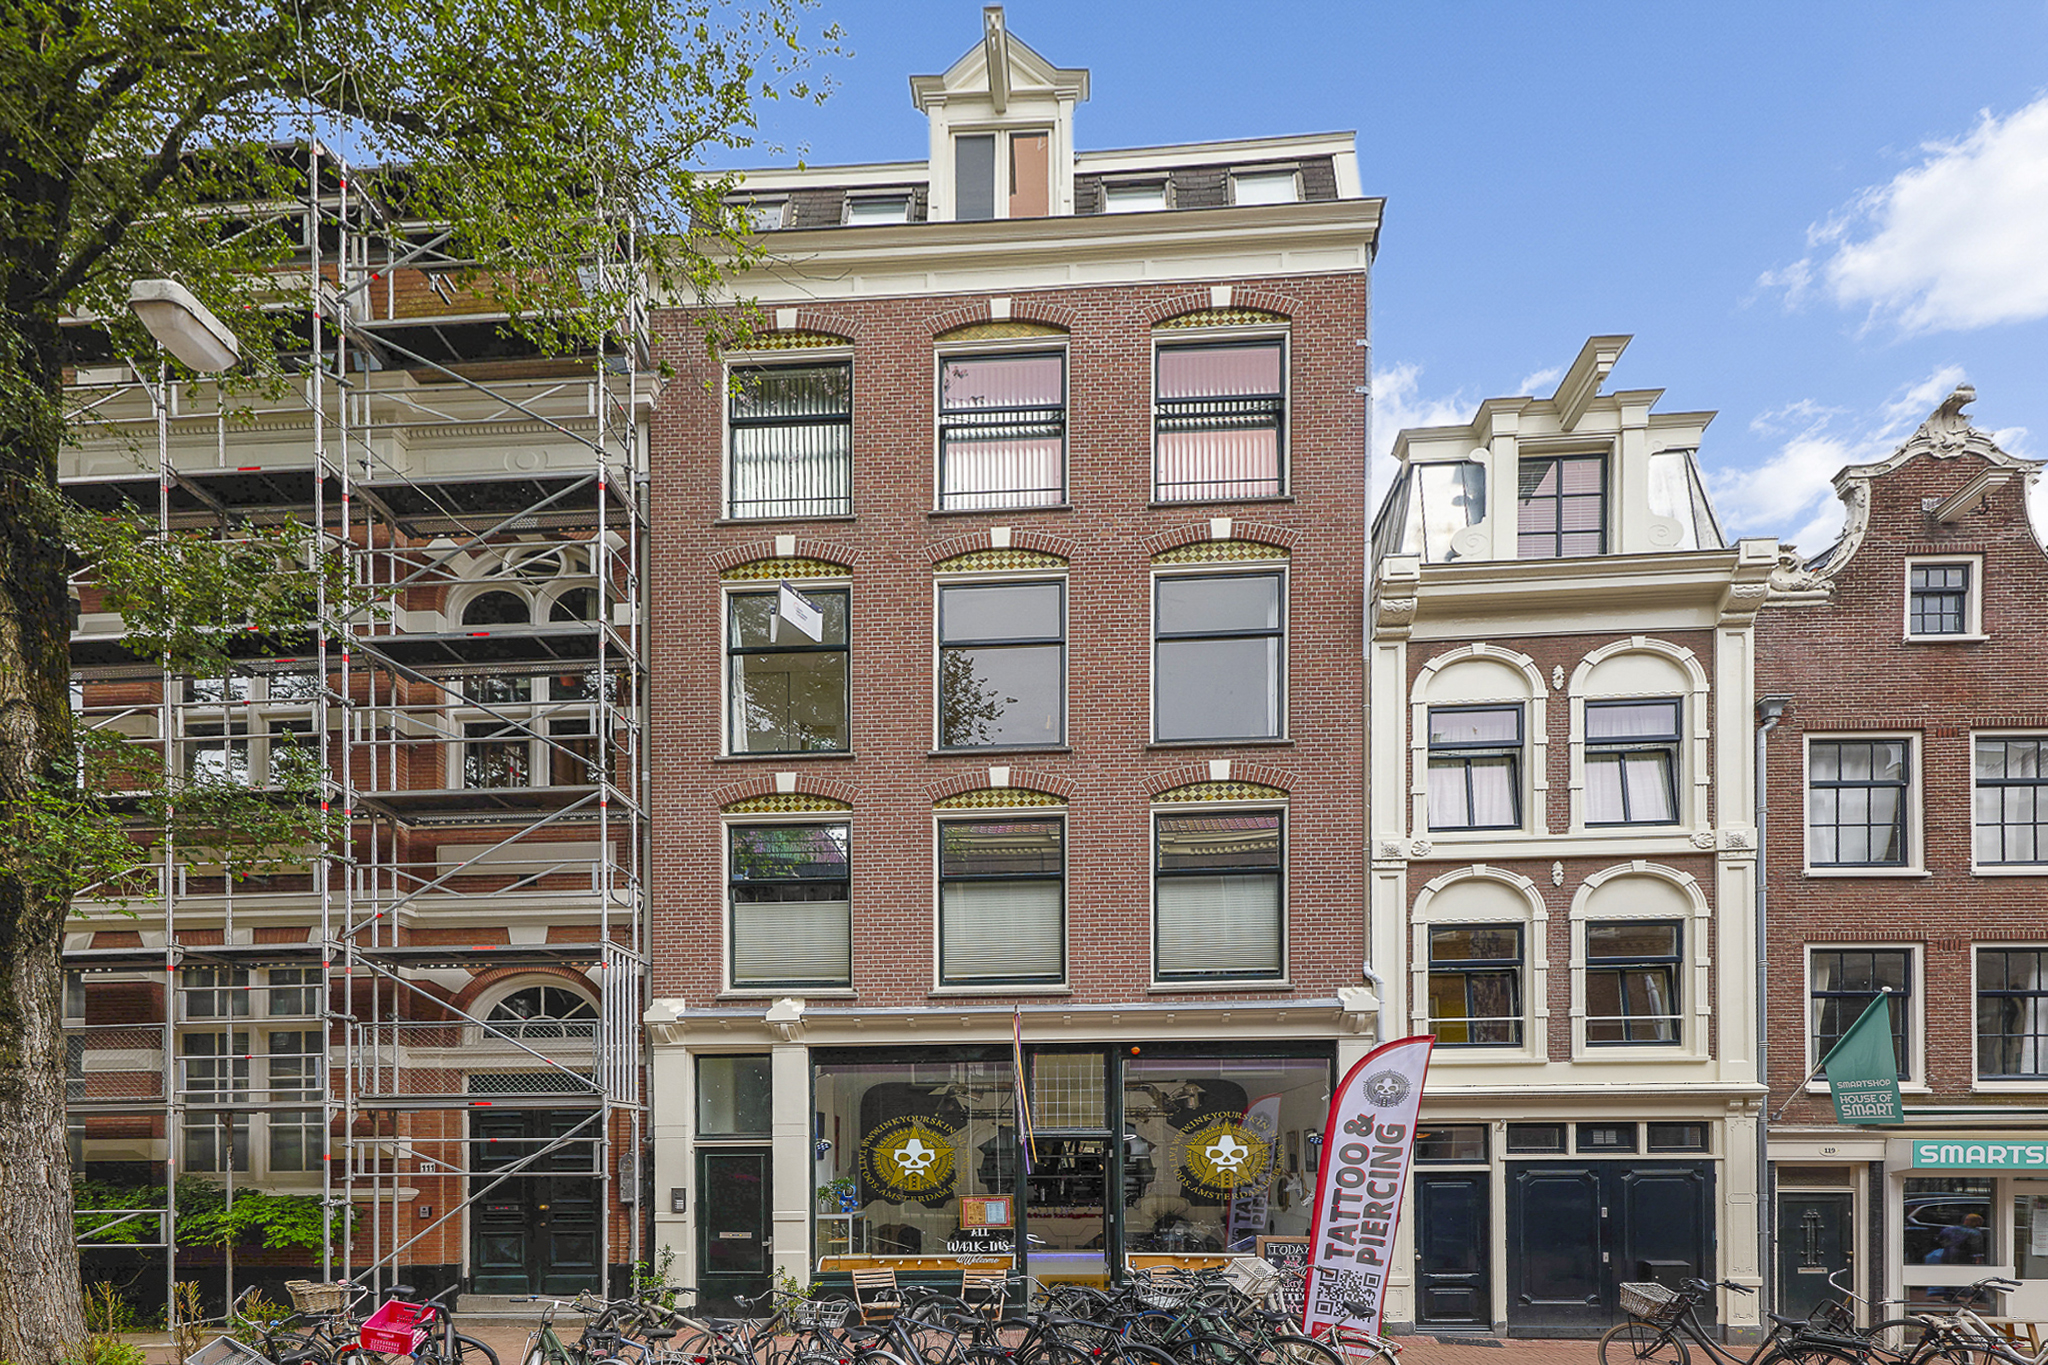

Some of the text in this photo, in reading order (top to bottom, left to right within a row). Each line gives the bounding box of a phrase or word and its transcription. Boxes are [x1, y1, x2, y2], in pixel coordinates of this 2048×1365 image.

[1836, 1079, 1891, 1089] SMARTSHOP
[1839, 1093, 1893, 1104] HOUSE OF
[1841, 1103, 1894, 1116] SMART
[1920, 1145, 2048, 1164] SMARTS
[421, 1164, 434, 1172] 111
[1323, 1113, 1376, 1260] TATTOO &
[1356, 1124, 1407, 1267] PIERCING
[970, 1228, 990, 1237] ALL
